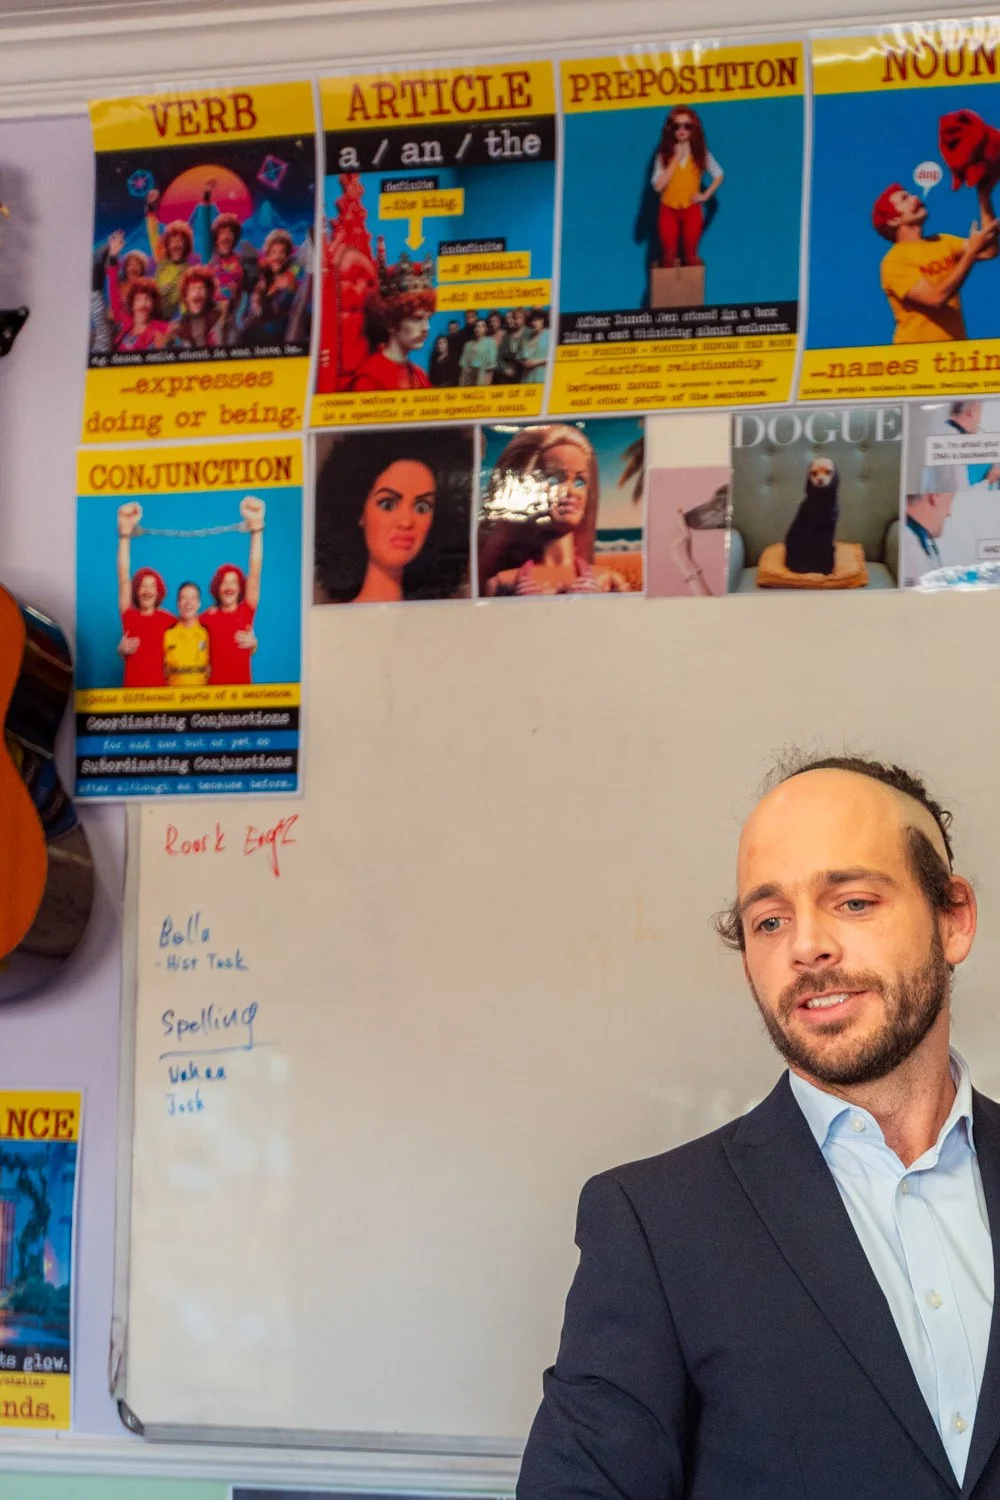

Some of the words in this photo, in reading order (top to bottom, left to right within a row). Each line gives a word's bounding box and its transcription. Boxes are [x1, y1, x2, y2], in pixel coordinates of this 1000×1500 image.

[568, 56, 799, 104] PREPOSITION
[881, 37, 998, 83] NOUN
[148, 92, 258, 137] VERB
[346, 70, 533, 122] ARTICLE
[338, 144, 361, 169] a
[400, 139, 444, 165] an
[484, 129, 543, 158] the
[86, 410, 164, 437] doing
[174, 410, 207, 429] or
[733, 406, 904, 449] DOGUE
[88, 454, 293, 491] CONJUNCTION
[85, 714, 187, 732] Coordinating
[189, 711, 291, 729] Conjunctions
[80, 757, 190, 776] Subordinating
[192, 754, 293, 773] Conjunctions
[160, 1001, 259, 1050] Spelling
[0, 1107, 76, 1140] NCE
